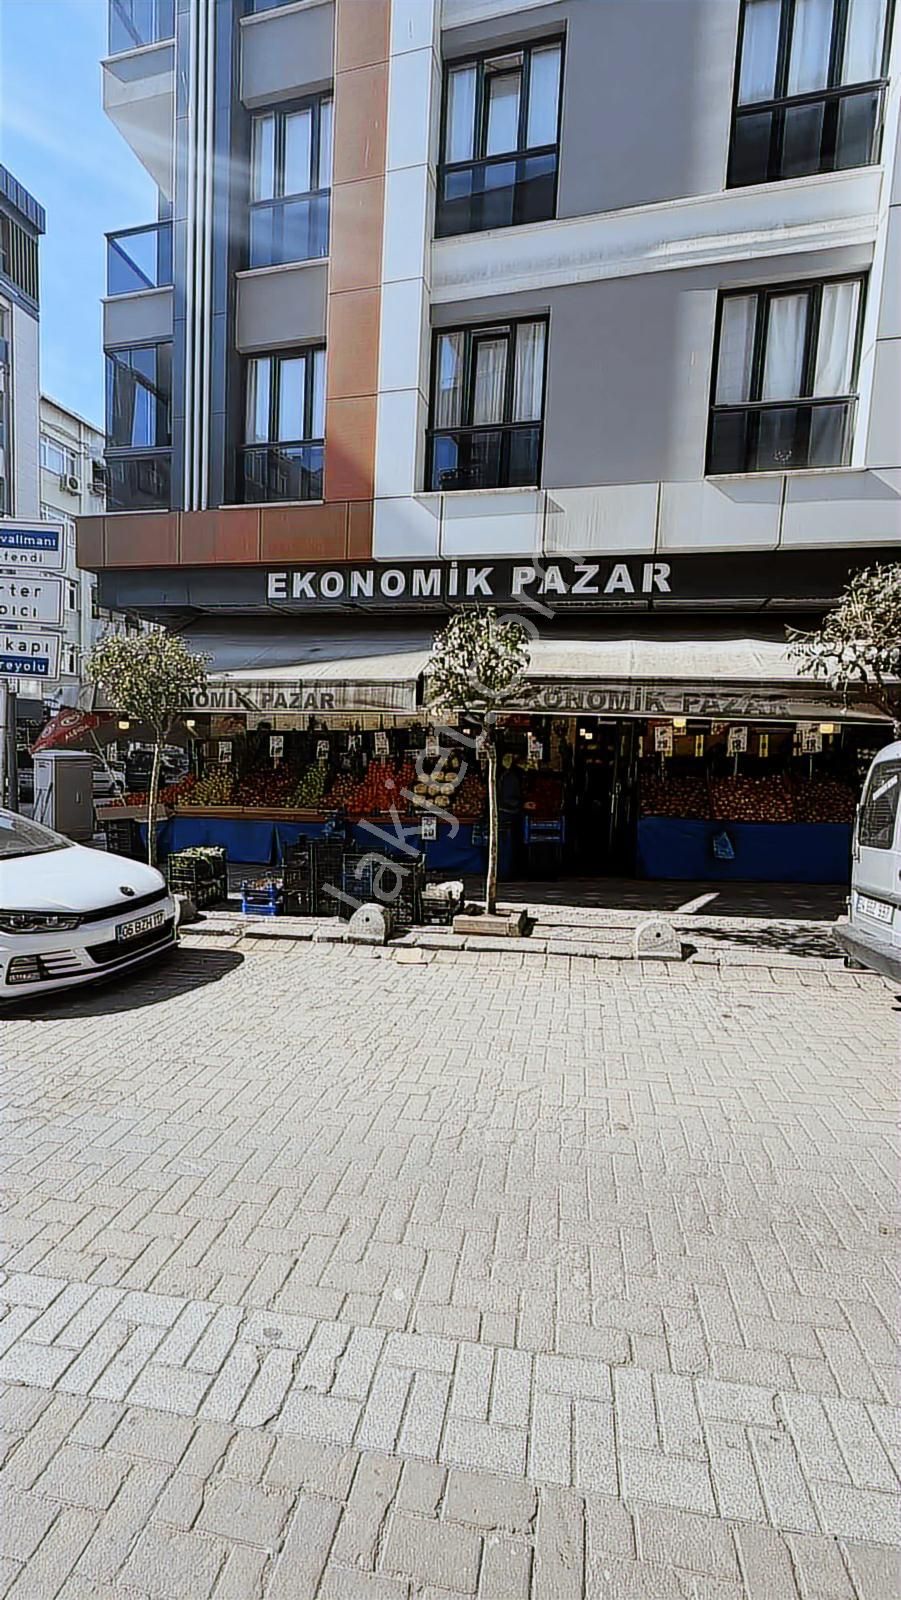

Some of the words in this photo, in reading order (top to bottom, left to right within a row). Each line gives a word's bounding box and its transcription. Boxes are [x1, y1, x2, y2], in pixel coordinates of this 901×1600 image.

[0, 551, 42, 562] fendi
[267, 562, 494, 599] EKONOMİK
[512, 563, 673, 595] PAZAR
[1, 637, 48, 656] kapı
[262, 691, 335, 709] PAZAR
